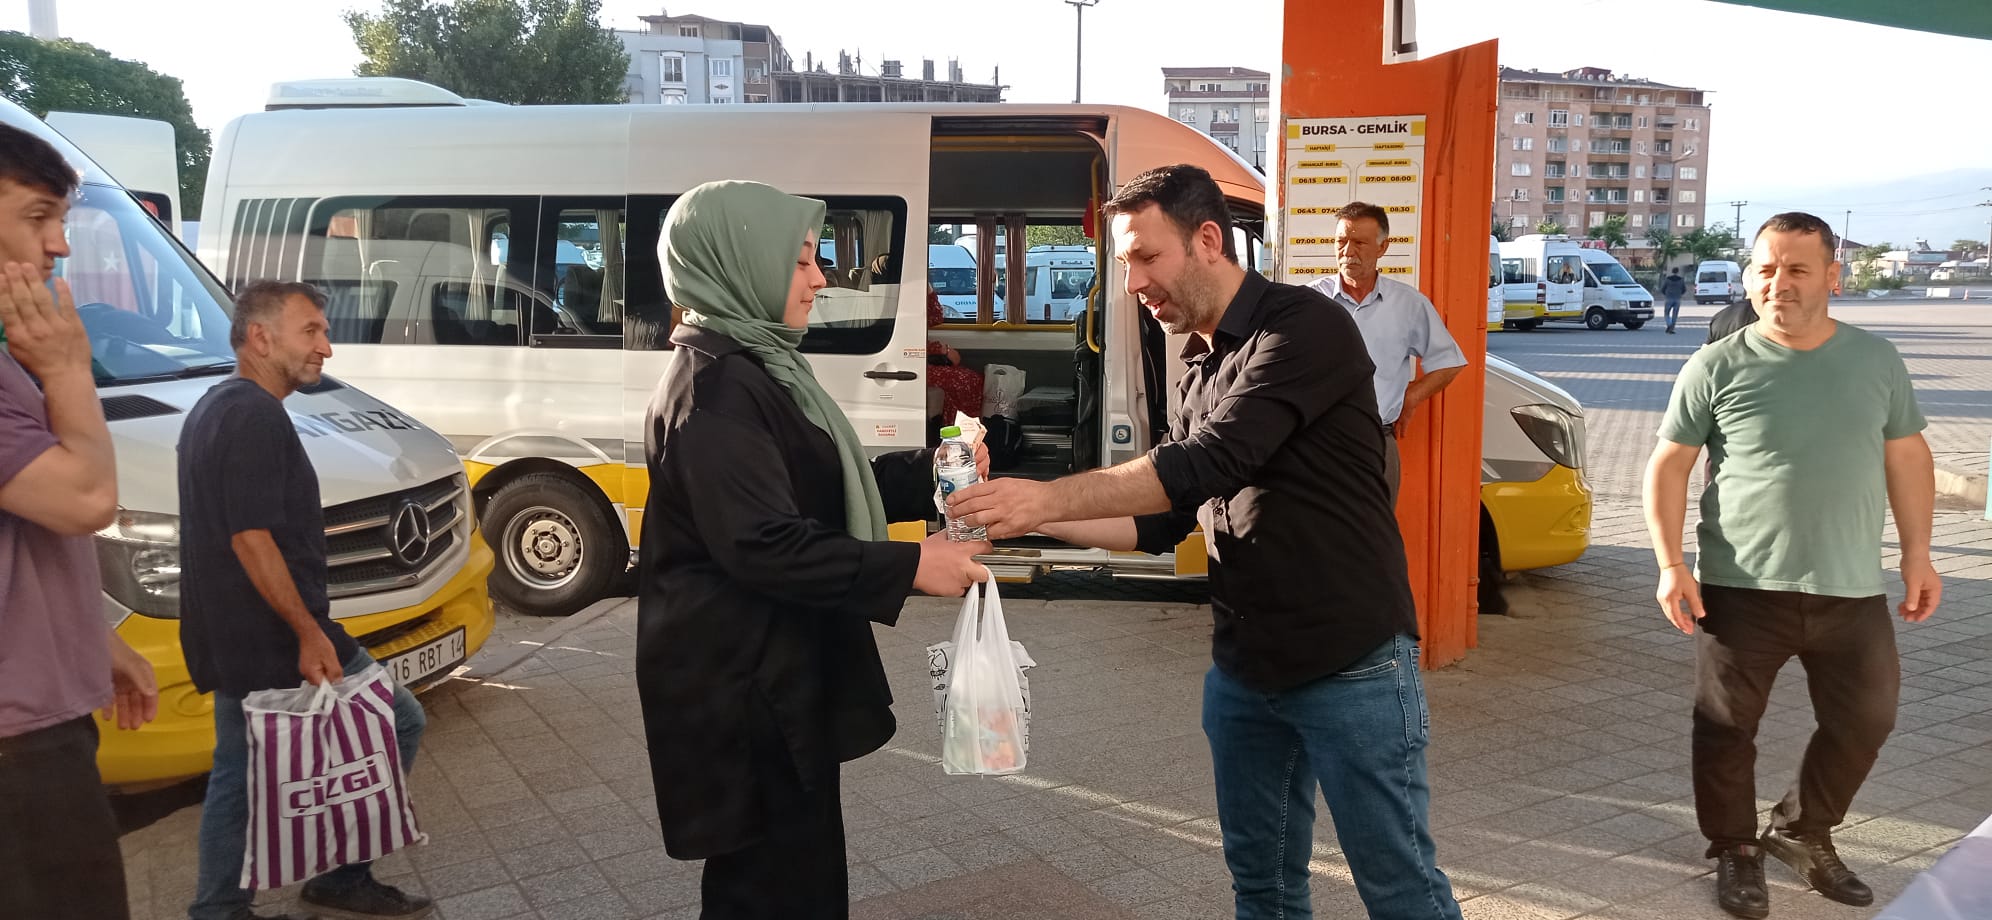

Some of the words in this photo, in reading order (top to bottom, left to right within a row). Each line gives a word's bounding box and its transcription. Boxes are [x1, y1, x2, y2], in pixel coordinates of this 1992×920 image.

[1302, 125, 1347, 135] BURSA
[1357, 120, 1408, 134] GEMLİK
[393, 657, 410, 681] 16
[419, 643, 442, 674] RBT
[451, 634, 464, 658] 14
